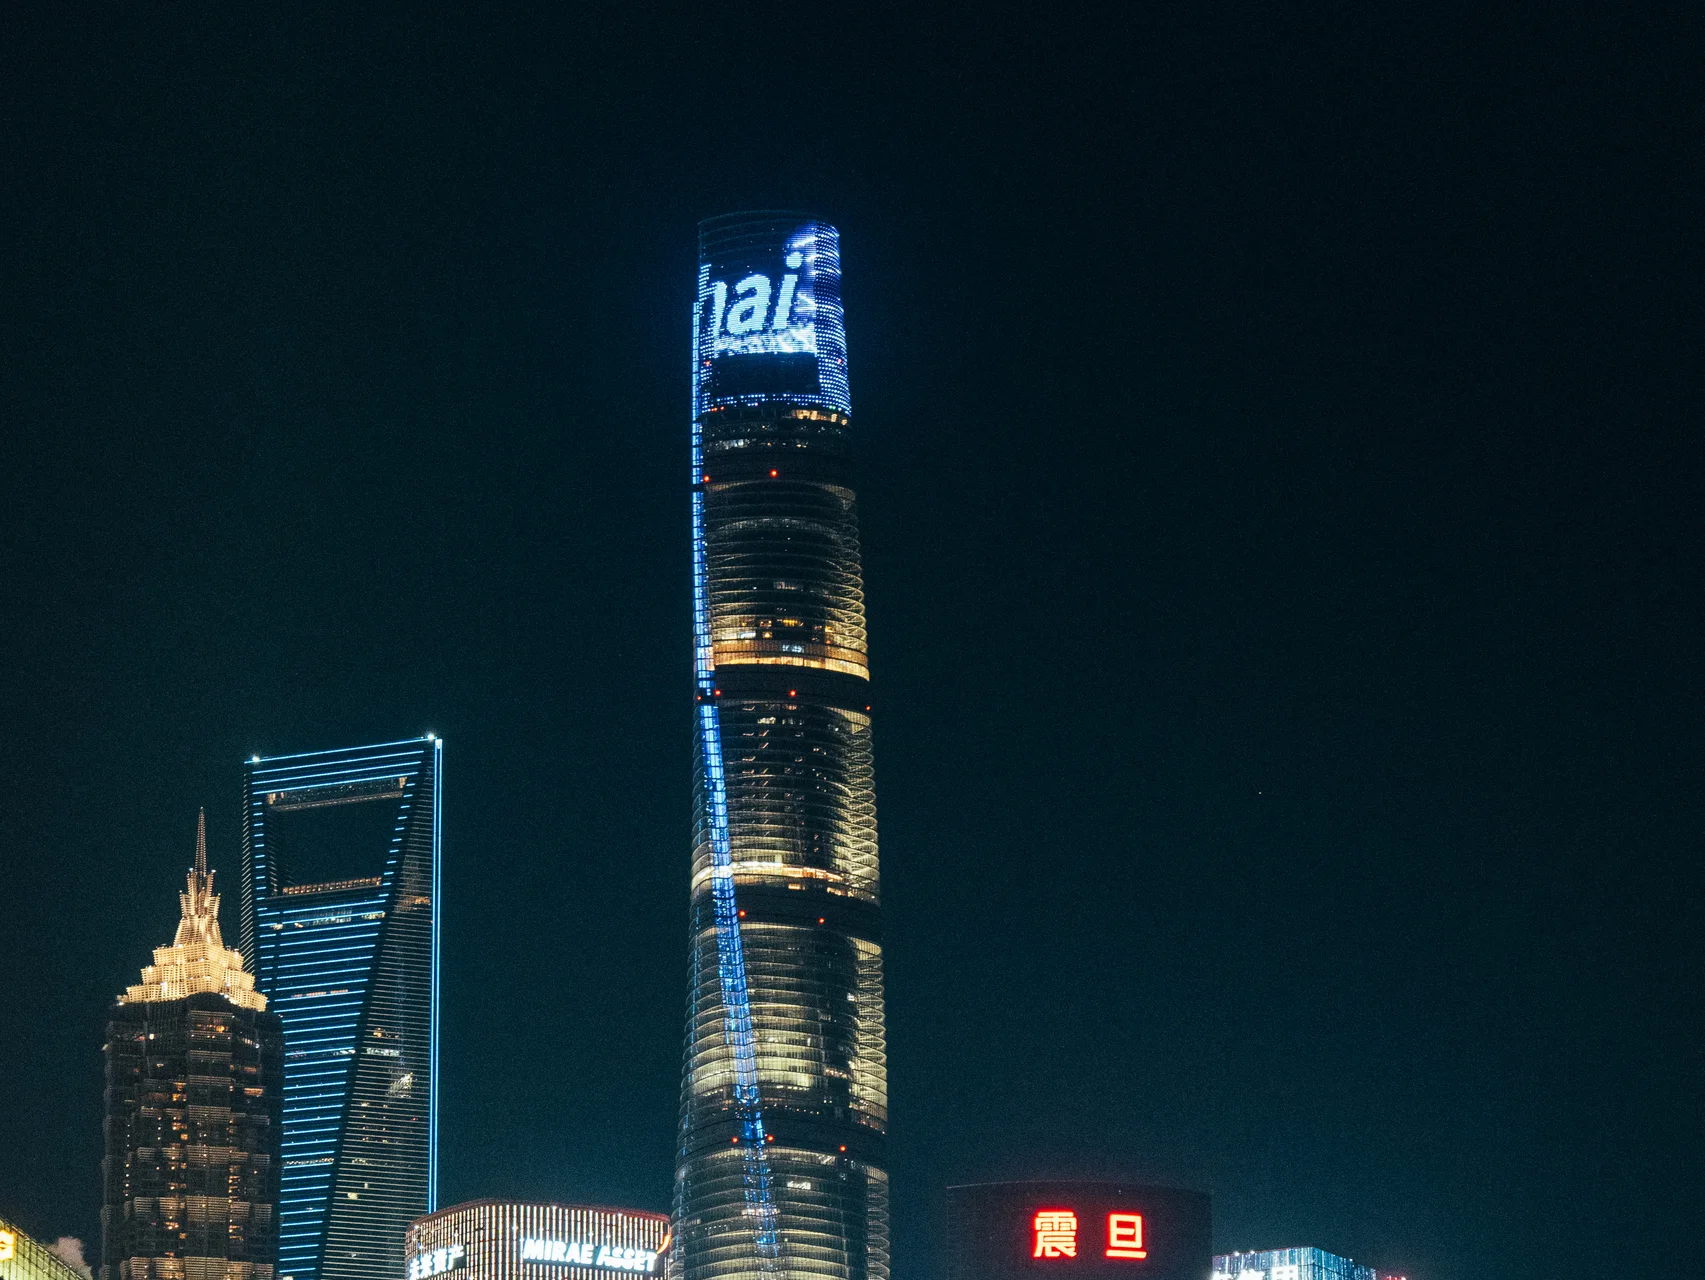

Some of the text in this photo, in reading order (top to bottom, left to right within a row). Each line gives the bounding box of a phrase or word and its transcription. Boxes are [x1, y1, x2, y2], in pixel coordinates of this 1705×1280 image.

[523, 1238, 658, 1272] MIRAE ASSET
[1033, 1211, 1148, 1260] 震旦
